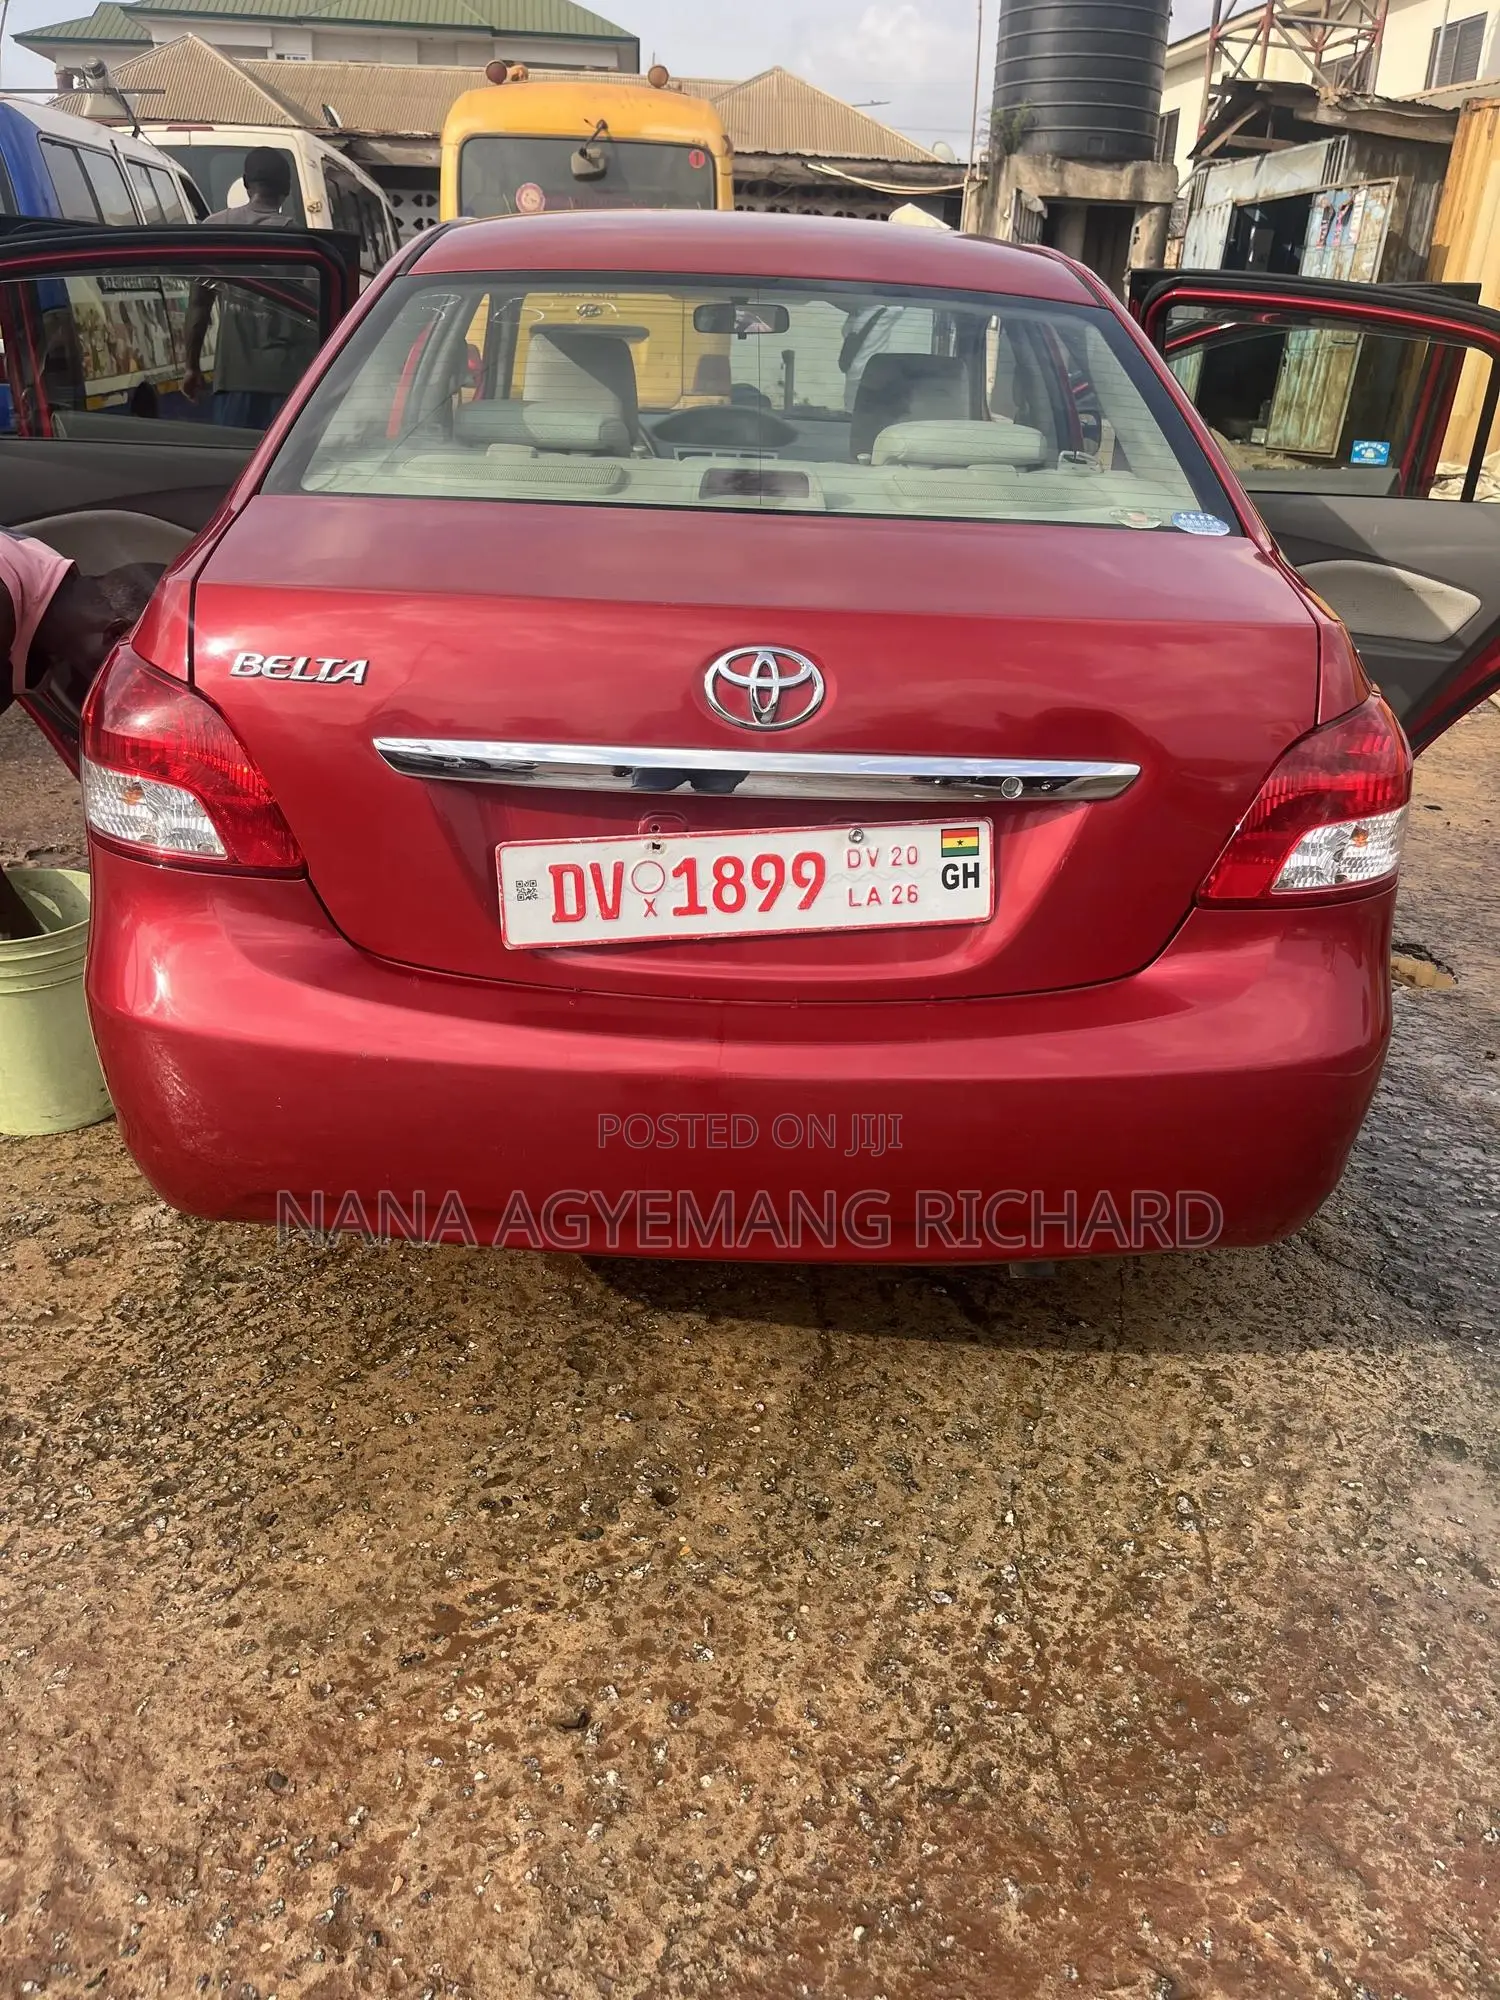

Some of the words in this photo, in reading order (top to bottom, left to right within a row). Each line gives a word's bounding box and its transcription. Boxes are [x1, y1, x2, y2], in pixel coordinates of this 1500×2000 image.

[230, 652, 369, 685] BELTA
[846, 847, 879, 869] DV
[891, 845, 918, 867] 20
[548, 861, 625, 923] DV
[671, 851, 826, 917] 1899
[941, 862, 980, 890] GH
[848, 886, 882, 907] LA
[892, 884, 919, 905] 26
